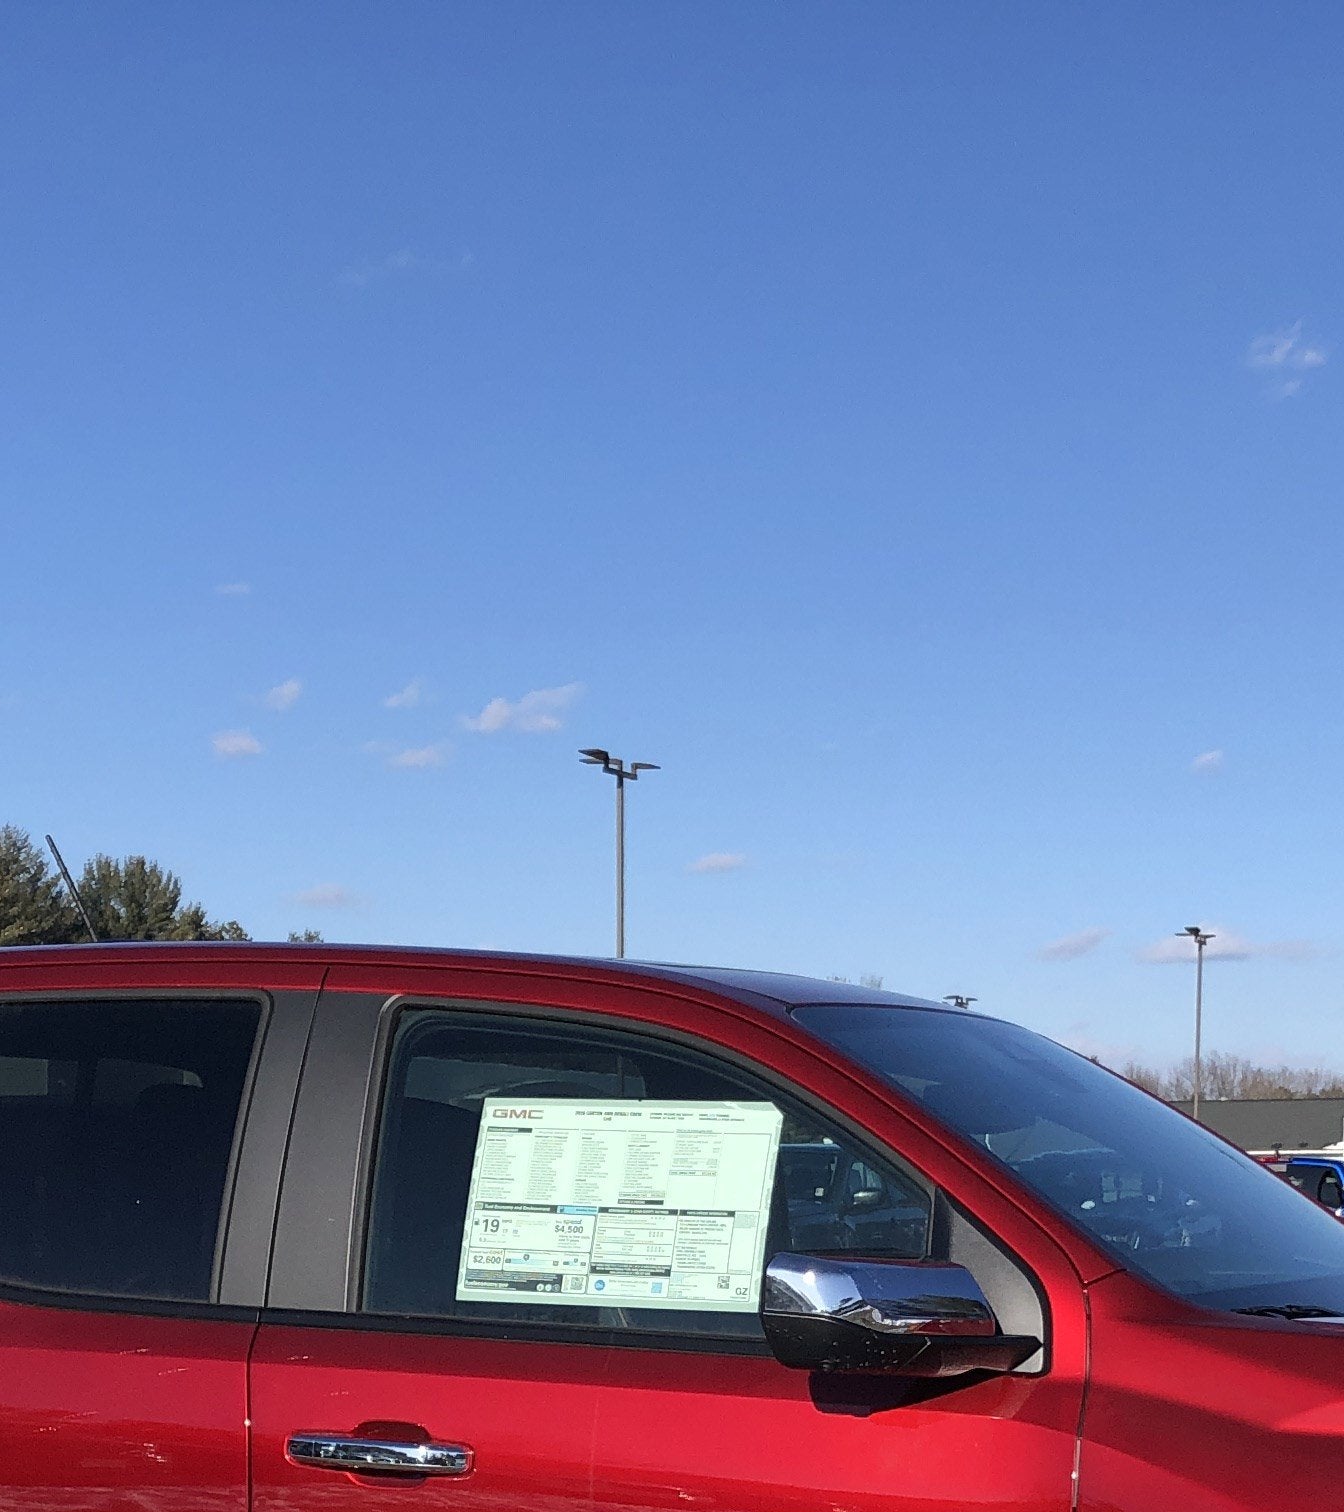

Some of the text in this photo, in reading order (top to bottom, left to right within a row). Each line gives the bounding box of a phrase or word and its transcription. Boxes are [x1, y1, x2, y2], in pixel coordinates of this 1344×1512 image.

[492, 1109, 544, 1119] GMC
[482, 1218, 500, 1233] 19
[555, 1225, 584, 1234] $4,500
[473, 1255, 501, 1264] $2,600
